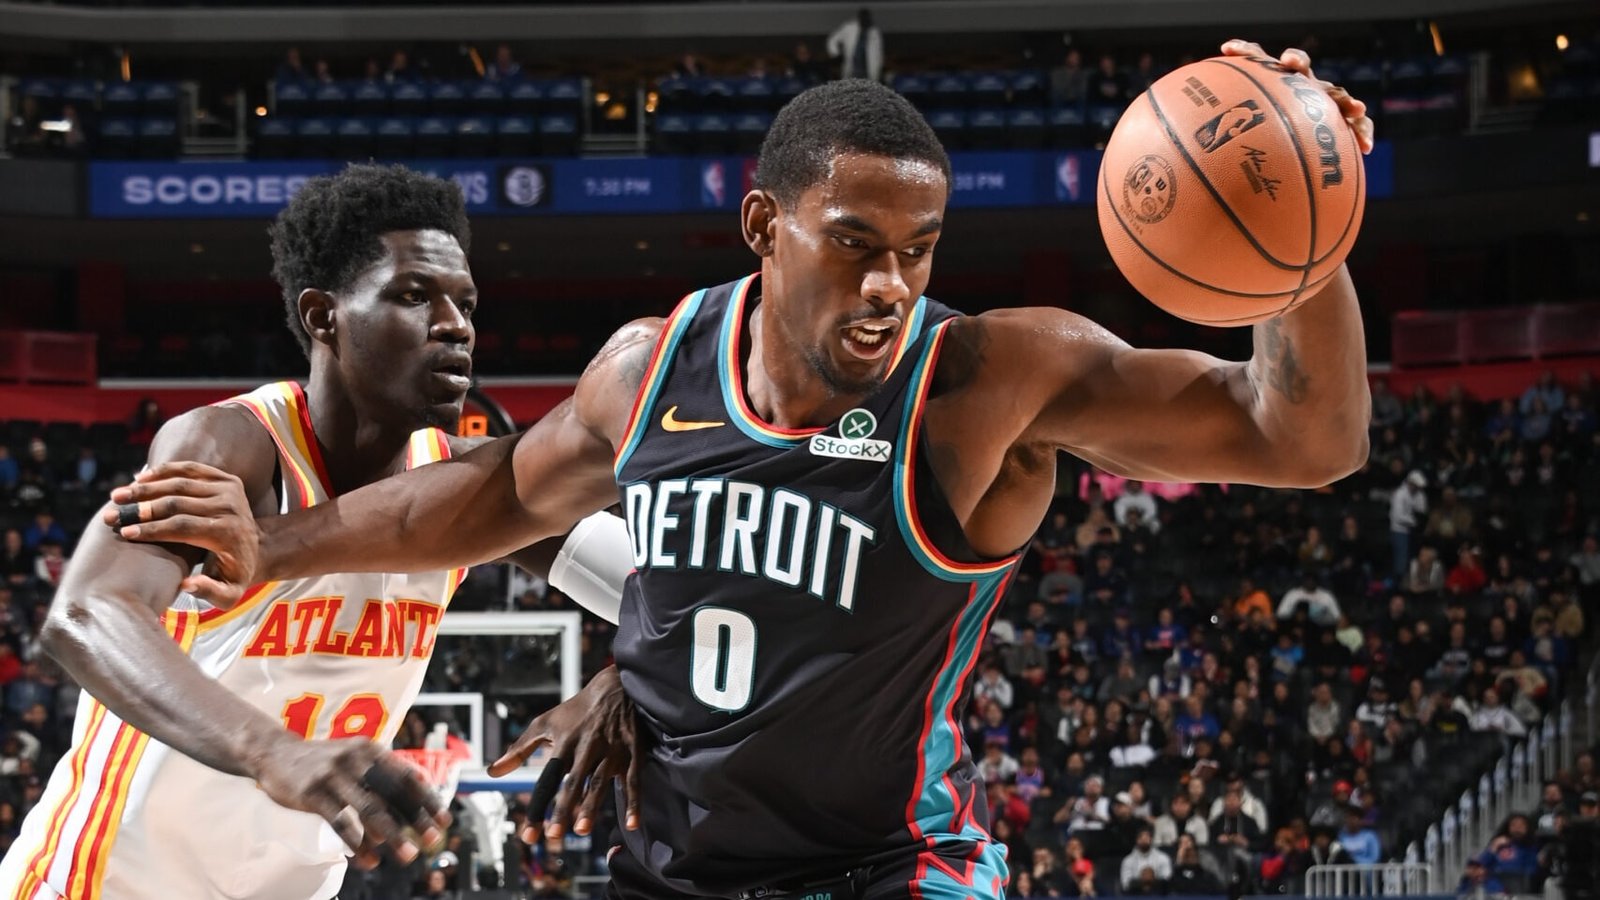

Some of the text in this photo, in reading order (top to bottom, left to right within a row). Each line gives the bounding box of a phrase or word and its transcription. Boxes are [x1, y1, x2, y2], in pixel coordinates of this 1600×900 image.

[813, 437, 889, 459] StockX
[623, 477, 878, 614] DETROIT
[241, 596, 445, 660] ATLANT
[690, 605, 757, 713] 0
